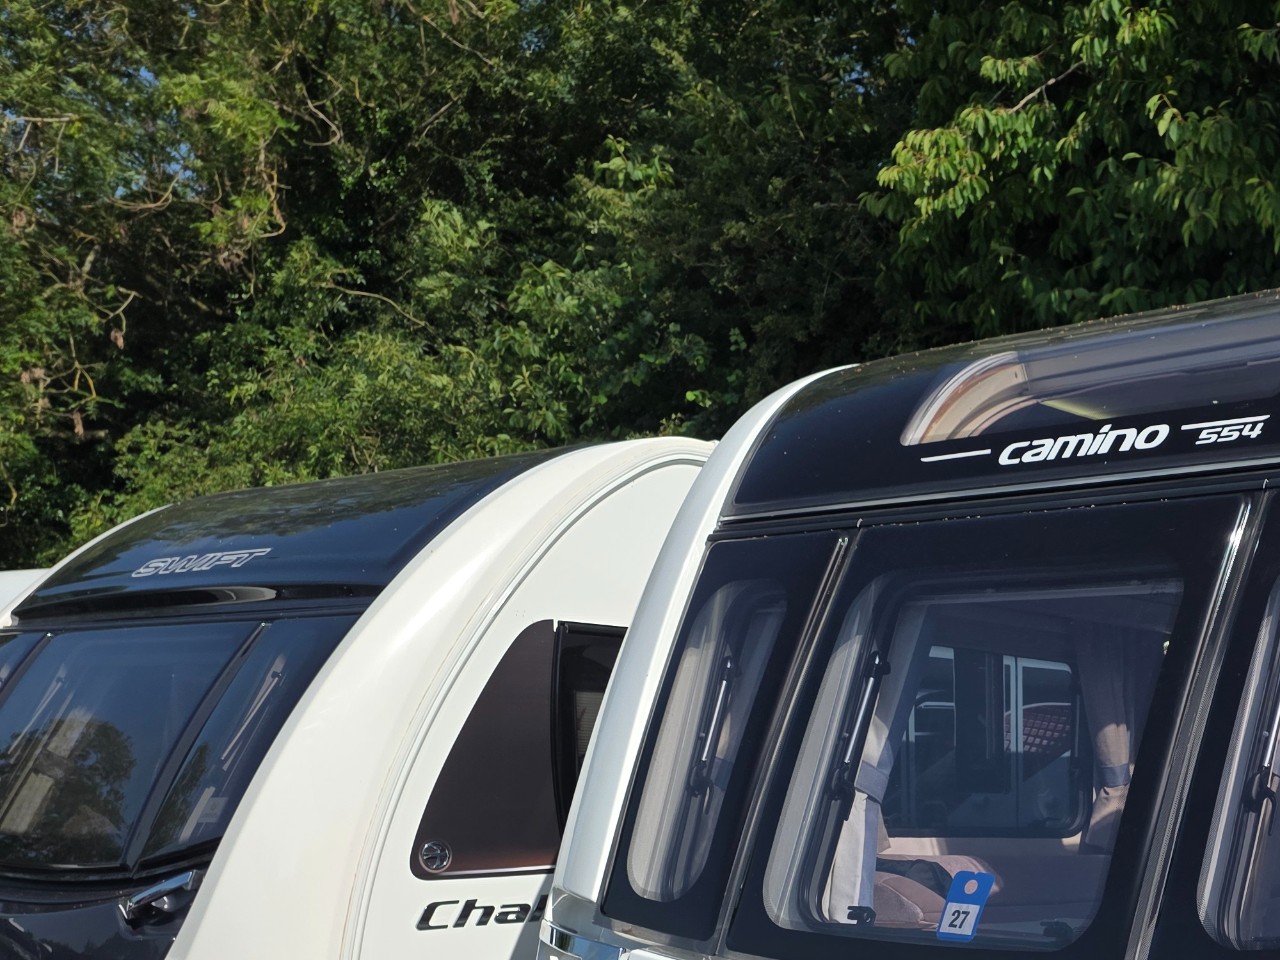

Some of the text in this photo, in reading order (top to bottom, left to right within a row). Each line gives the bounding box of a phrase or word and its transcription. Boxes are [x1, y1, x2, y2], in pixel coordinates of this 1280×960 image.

[998, 422, 1265, 466] camino 554
[131, 547, 273, 578] SWIFT
[947, 909, 971, 929] 27
